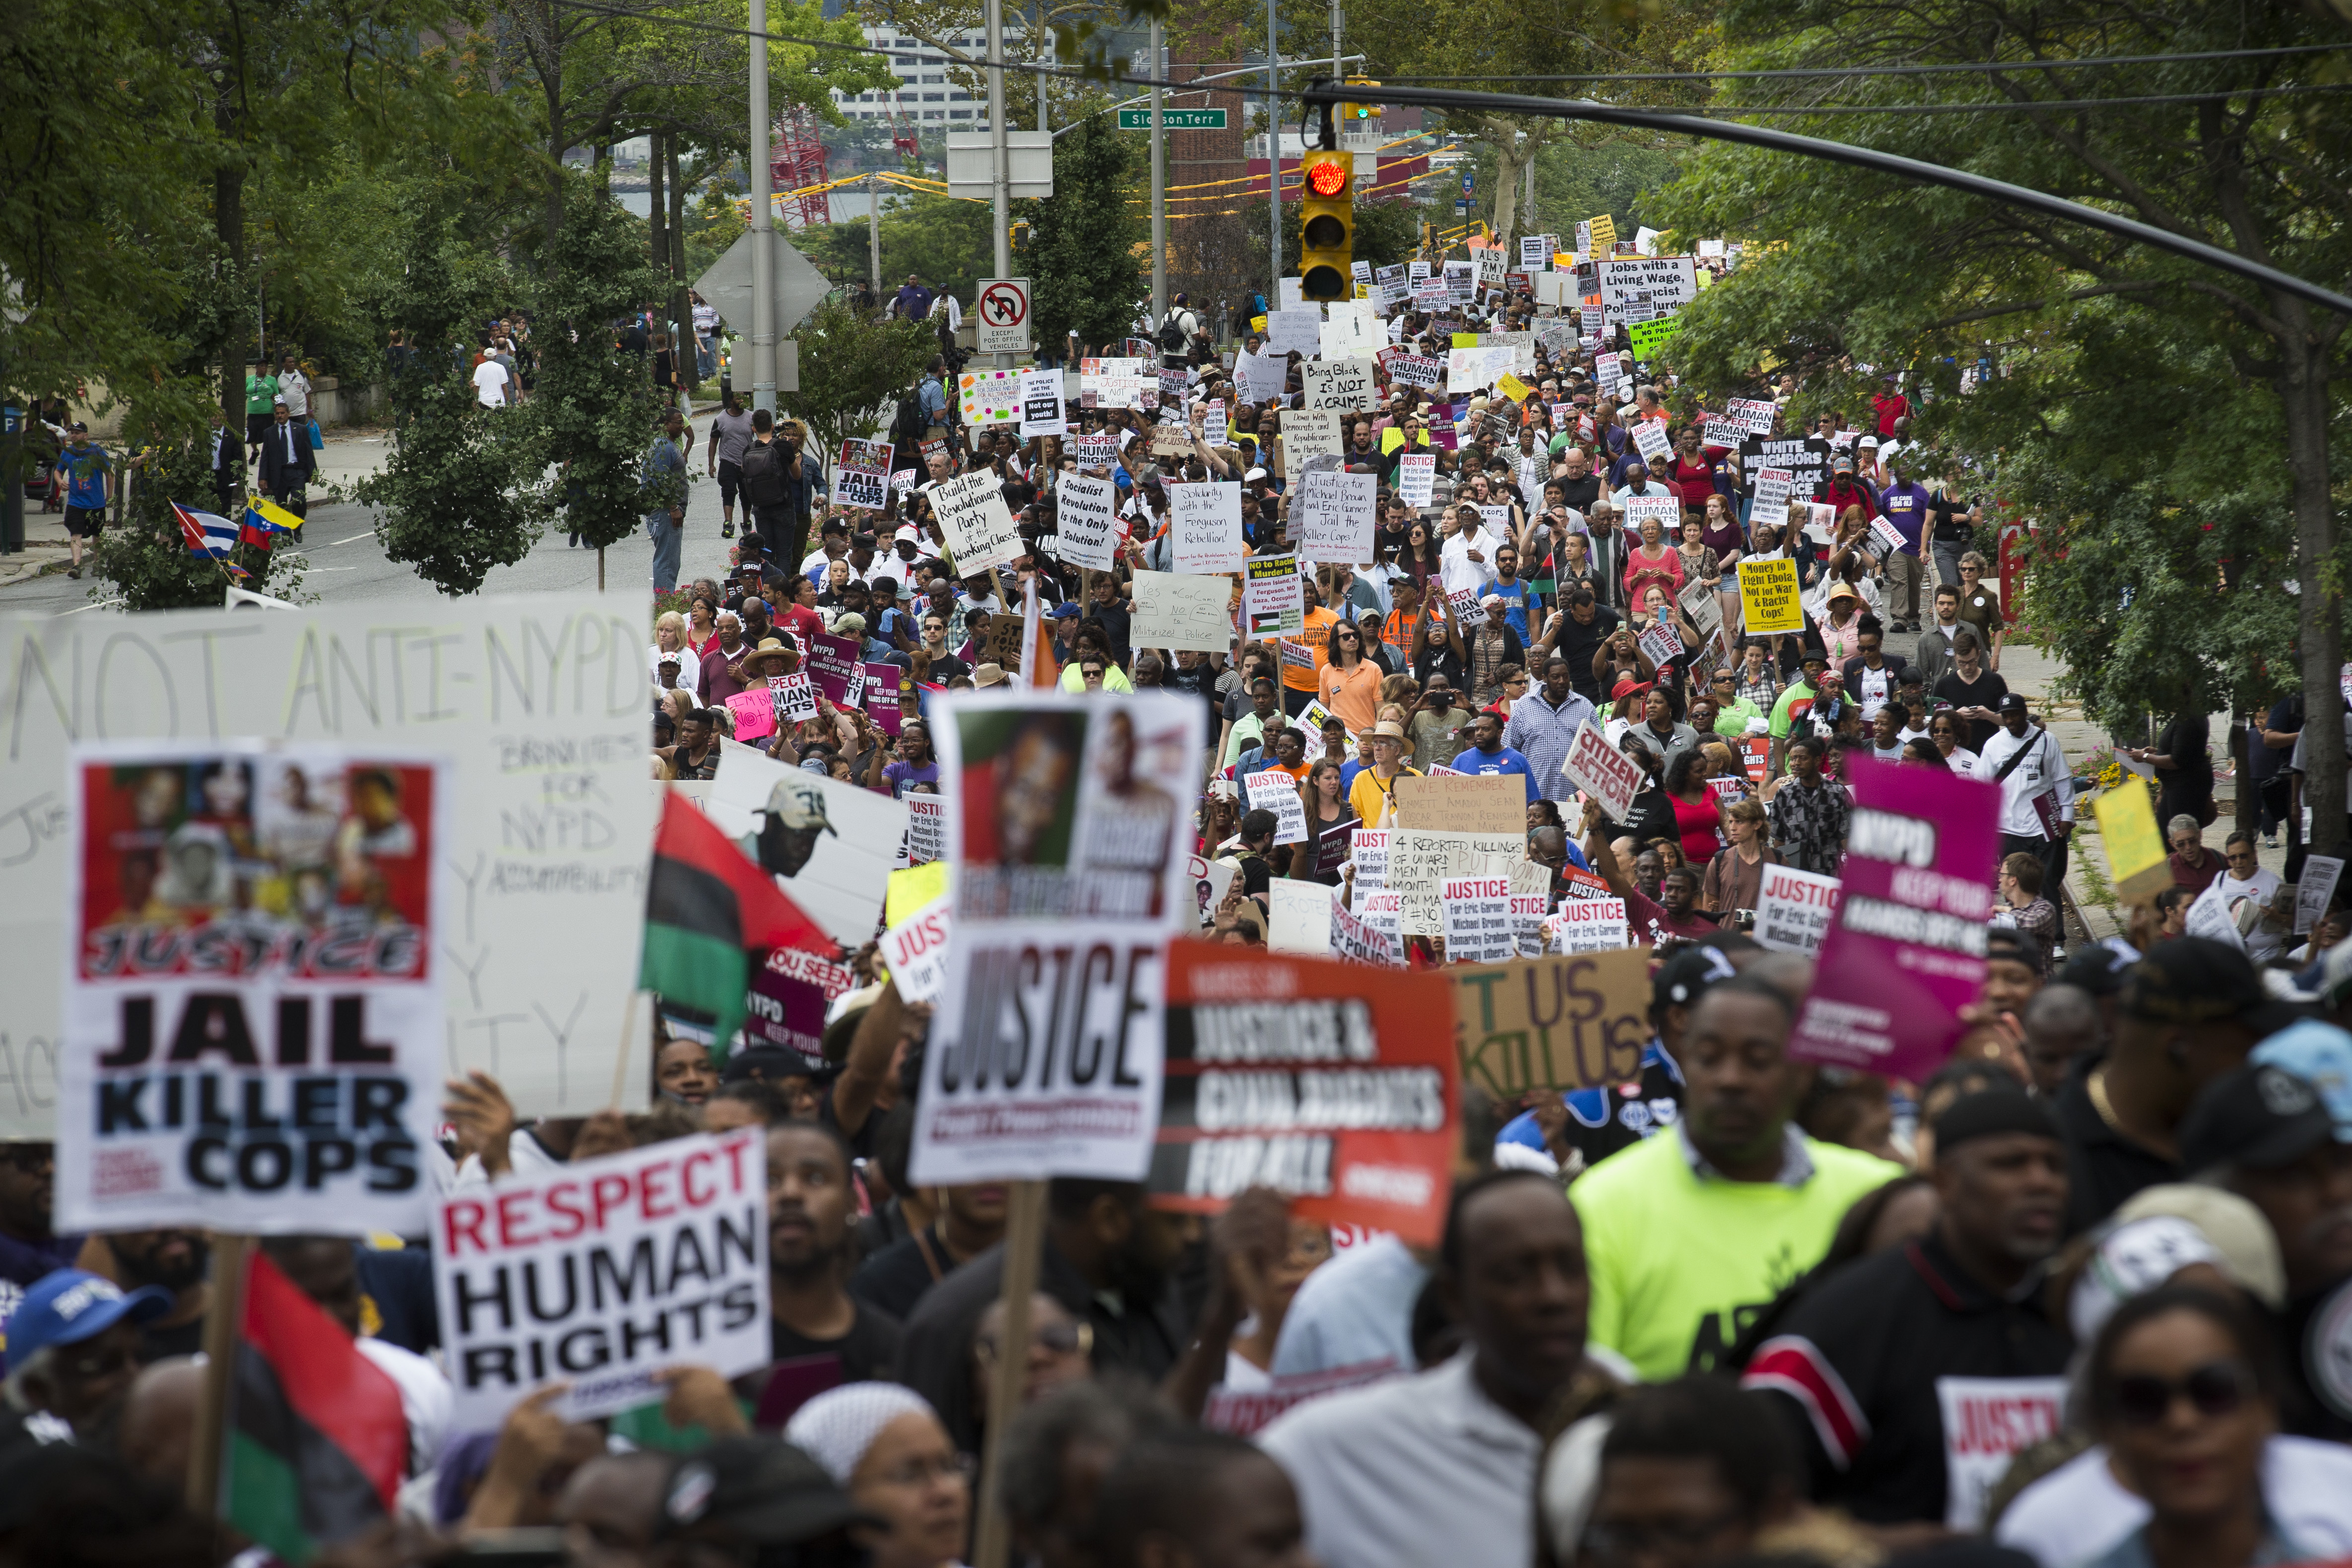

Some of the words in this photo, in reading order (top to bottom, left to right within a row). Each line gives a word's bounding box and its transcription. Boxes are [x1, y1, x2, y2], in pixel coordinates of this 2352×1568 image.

[1132, 115, 1182, 125] Sloson
[1186, 114, 1213, 124] Terr
[1610, 262, 1637, 273] Jobs
[1641, 262, 1667, 270] with
[1607, 276, 1643, 286] Living
[1646, 274, 1685, 284] Wage,
[1420, 302, 1448, 310] BRUTALITY
[1396, 353, 1439, 366] RESPECT
[1307, 364, 1333, 383] Being
[1334, 363, 1360, 376] Black
[1395, 361, 1437, 378] HUMAN
[1338, 379, 1366, 392] NOT
[1394, 373, 1435, 384] RIGHTS
[1314, 398, 1323, 409] A
[1324, 396, 1368, 409] CRIME
[1031, 409, 1053, 418] youth!
[1294, 433, 1330, 442] Republicans
[1080, 444, 1117, 456] HUMAN
[1761, 441, 1805, 455] WHITE
[1402, 457, 1435, 465] JUSTICE
[1744, 453, 1822, 467] NEIGHBORS
[841, 462, 887, 475] JUSTICE
[1759, 468, 1792, 482] JUSTICE
[840, 472, 882, 488] JAIL
[1310, 473, 1348, 486] Justice
[1352, 477, 1366, 489] for
[839, 483, 883, 496] KILLER
[937, 479, 965, 501] Build
[967, 475, 985, 490] the
[1064, 479, 1104, 497] Socialist
[1181, 486, 1222, 501] Solidarity
[1307, 488, 1337, 499] Michael
[1340, 490, 1367, 502] Brown
[850, 492, 884, 505] COPS
[938, 488, 1003, 521] Revolutionary
[1061, 494, 1108, 514] Revolution
[1179, 501, 1197, 511] with
[1202, 500, 1215, 510] the
[1306, 500, 1319, 510] and
[1322, 500, 1340, 511] Eric
[1342, 502, 1372, 514] Garner!
[957, 510, 987, 531] Party
[1060, 511, 1067, 521] Is
[1069, 514, 1083, 525] the
[1086, 518, 1109, 533] Only
[1185, 514, 1227, 527] Ferguson
[1320, 514, 1339, 526] Jail
[1345, 514, 1359, 528] the
[965, 533, 975, 544] of
[976, 527, 990, 536] the
[1064, 530, 1105, 547] Solution!
[1185, 529, 1228, 543] Rebellion!
[1304, 526, 1327, 541] Killer
[1330, 530, 1357, 541] Cops!
[953, 540, 992, 563] Working
[990, 527, 1019, 546] Class!
[1274, 557, 1296, 567] Racist
[1746, 564, 1773, 574] Money
[1777, 561, 1786, 571] to
[1255, 569, 1283, 578] Murder
[1742, 574, 1764, 586] Fight
[1766, 572, 1796, 584] Ebola,
[1140, 580, 1160, 597] Yes
[1172, 588, 1216, 603] #CopCams
[1745, 587, 1760, 596] Not
[1762, 586, 1773, 595] for
[1774, 584, 1793, 594] War
[1271, 593, 1297, 603] Occupied
[1762, 596, 1789, 606] Racist
[1172, 605, 1185, 614] NO
[1761, 607, 1784, 619] Cops!
[1132, 625, 1175, 638] Militarized
[812, 645, 836, 655] NYPD
[810, 661, 830, 670] HANDS
[838, 659, 851, 668] YOUR
[866, 677, 882, 685] NYPD
[1579, 728, 1641, 792] CITIZEN
[1414, 780, 1440, 793] WE
[1445, 779, 1505, 791] REMEMBER
[1572, 753, 1635, 810] ACTION
[1396, 837, 1406, 850] 4
[1413, 837, 1468, 850] REPORTED
[1474, 842, 1523, 853] KILLINGS
[1444, 880, 1508, 899] JUSTICE
[1526, 958, 1603, 1027] US
[941, 946, 1157, 1089] JUSTICE
[98, 994, 393, 1067] JAIL
[1573, 1016, 1641, 1087] US
[95, 1076, 412, 1135] KILLER
[186, 1134, 419, 1191] COPS
[443, 1136, 752, 1257] RESPECT
[454, 1206, 755, 1334] HUMAN
[463, 1284, 757, 1389] RIGHTS
